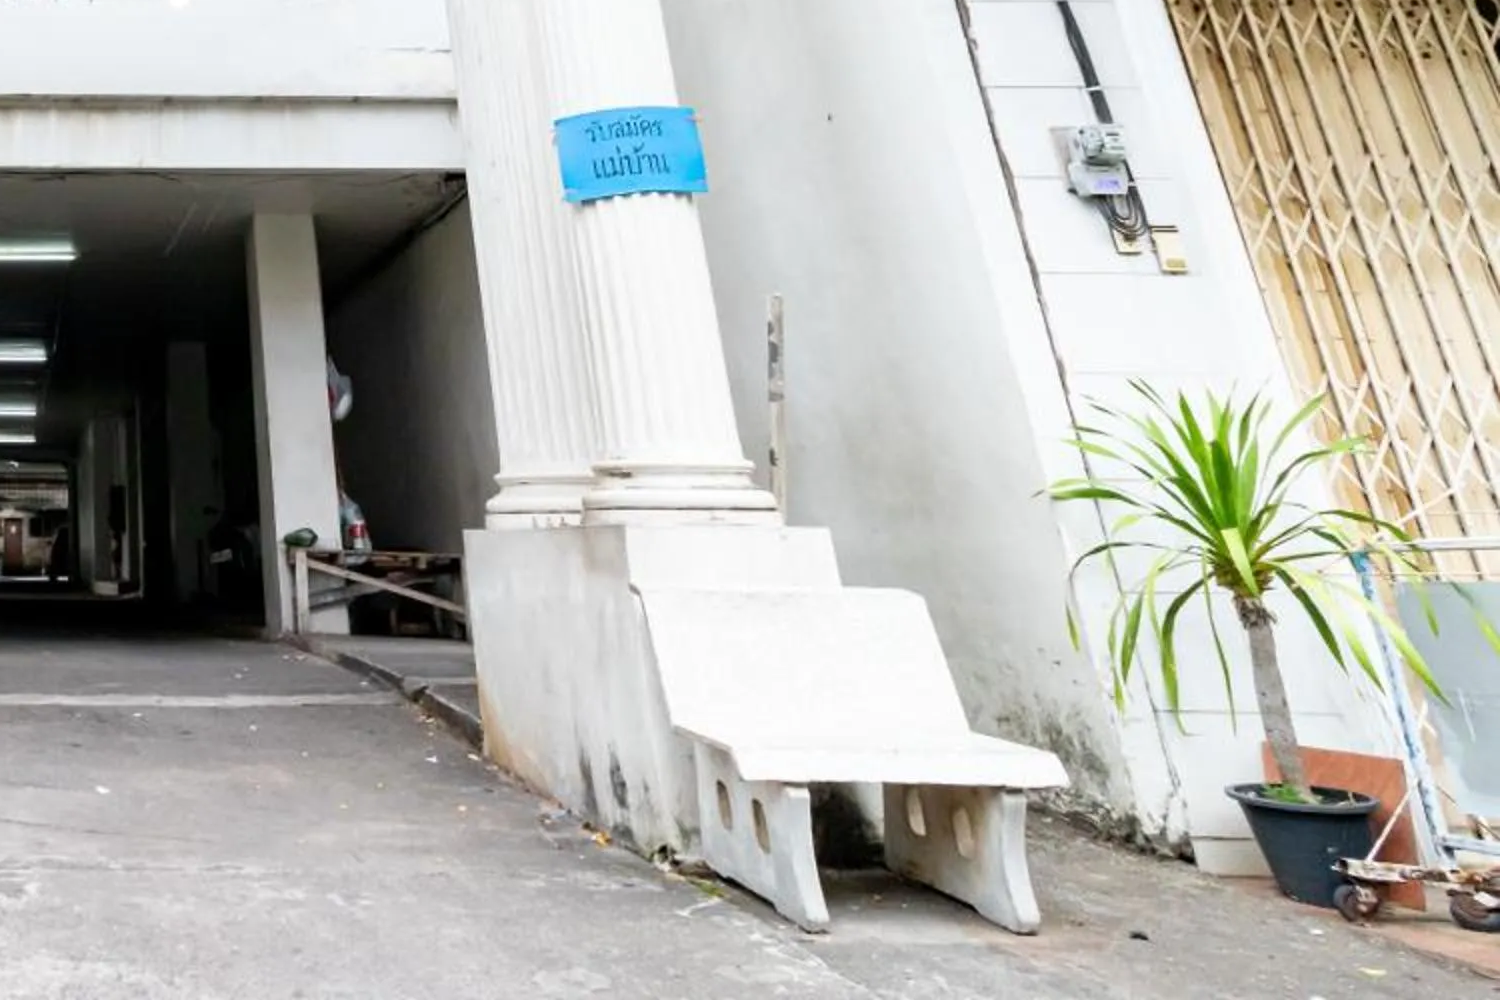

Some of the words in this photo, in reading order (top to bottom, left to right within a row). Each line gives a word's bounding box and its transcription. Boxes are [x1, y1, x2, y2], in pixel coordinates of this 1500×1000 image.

[585, 115, 664, 142] รับสมัคร
[593, 144, 671, 178] แม่บ้าน
